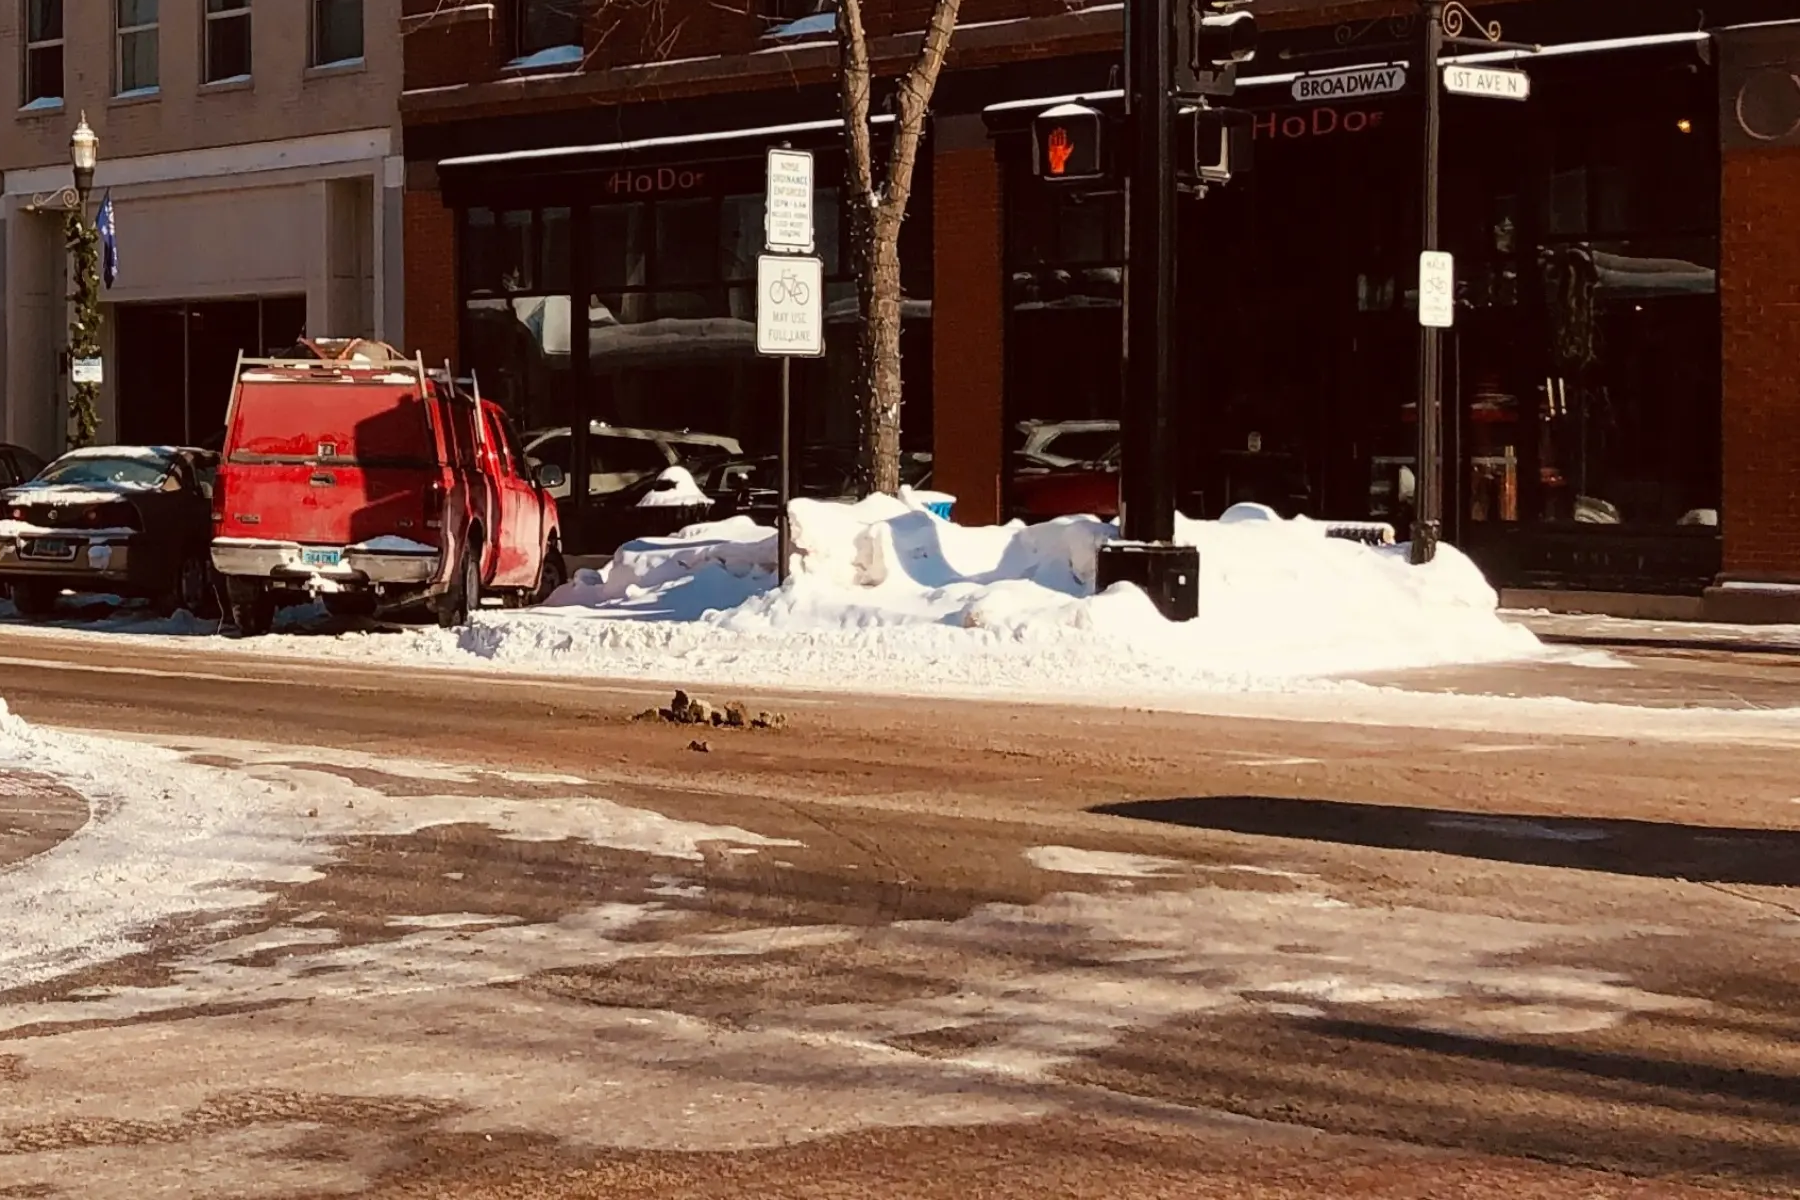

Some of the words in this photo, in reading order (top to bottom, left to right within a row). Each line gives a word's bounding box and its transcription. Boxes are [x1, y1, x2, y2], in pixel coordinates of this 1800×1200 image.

[1300, 70, 1397, 98] BROADWAY
[1453, 72, 1472, 89] 1ST
[1477, 74, 1501, 90] AVE
[1507, 77, 1517, 93] N
[773, 310, 788, 322] MAY
[791, 311, 807, 324] USE
[768, 329, 787, 342] FULL
[790, 330, 811, 342] LANE
